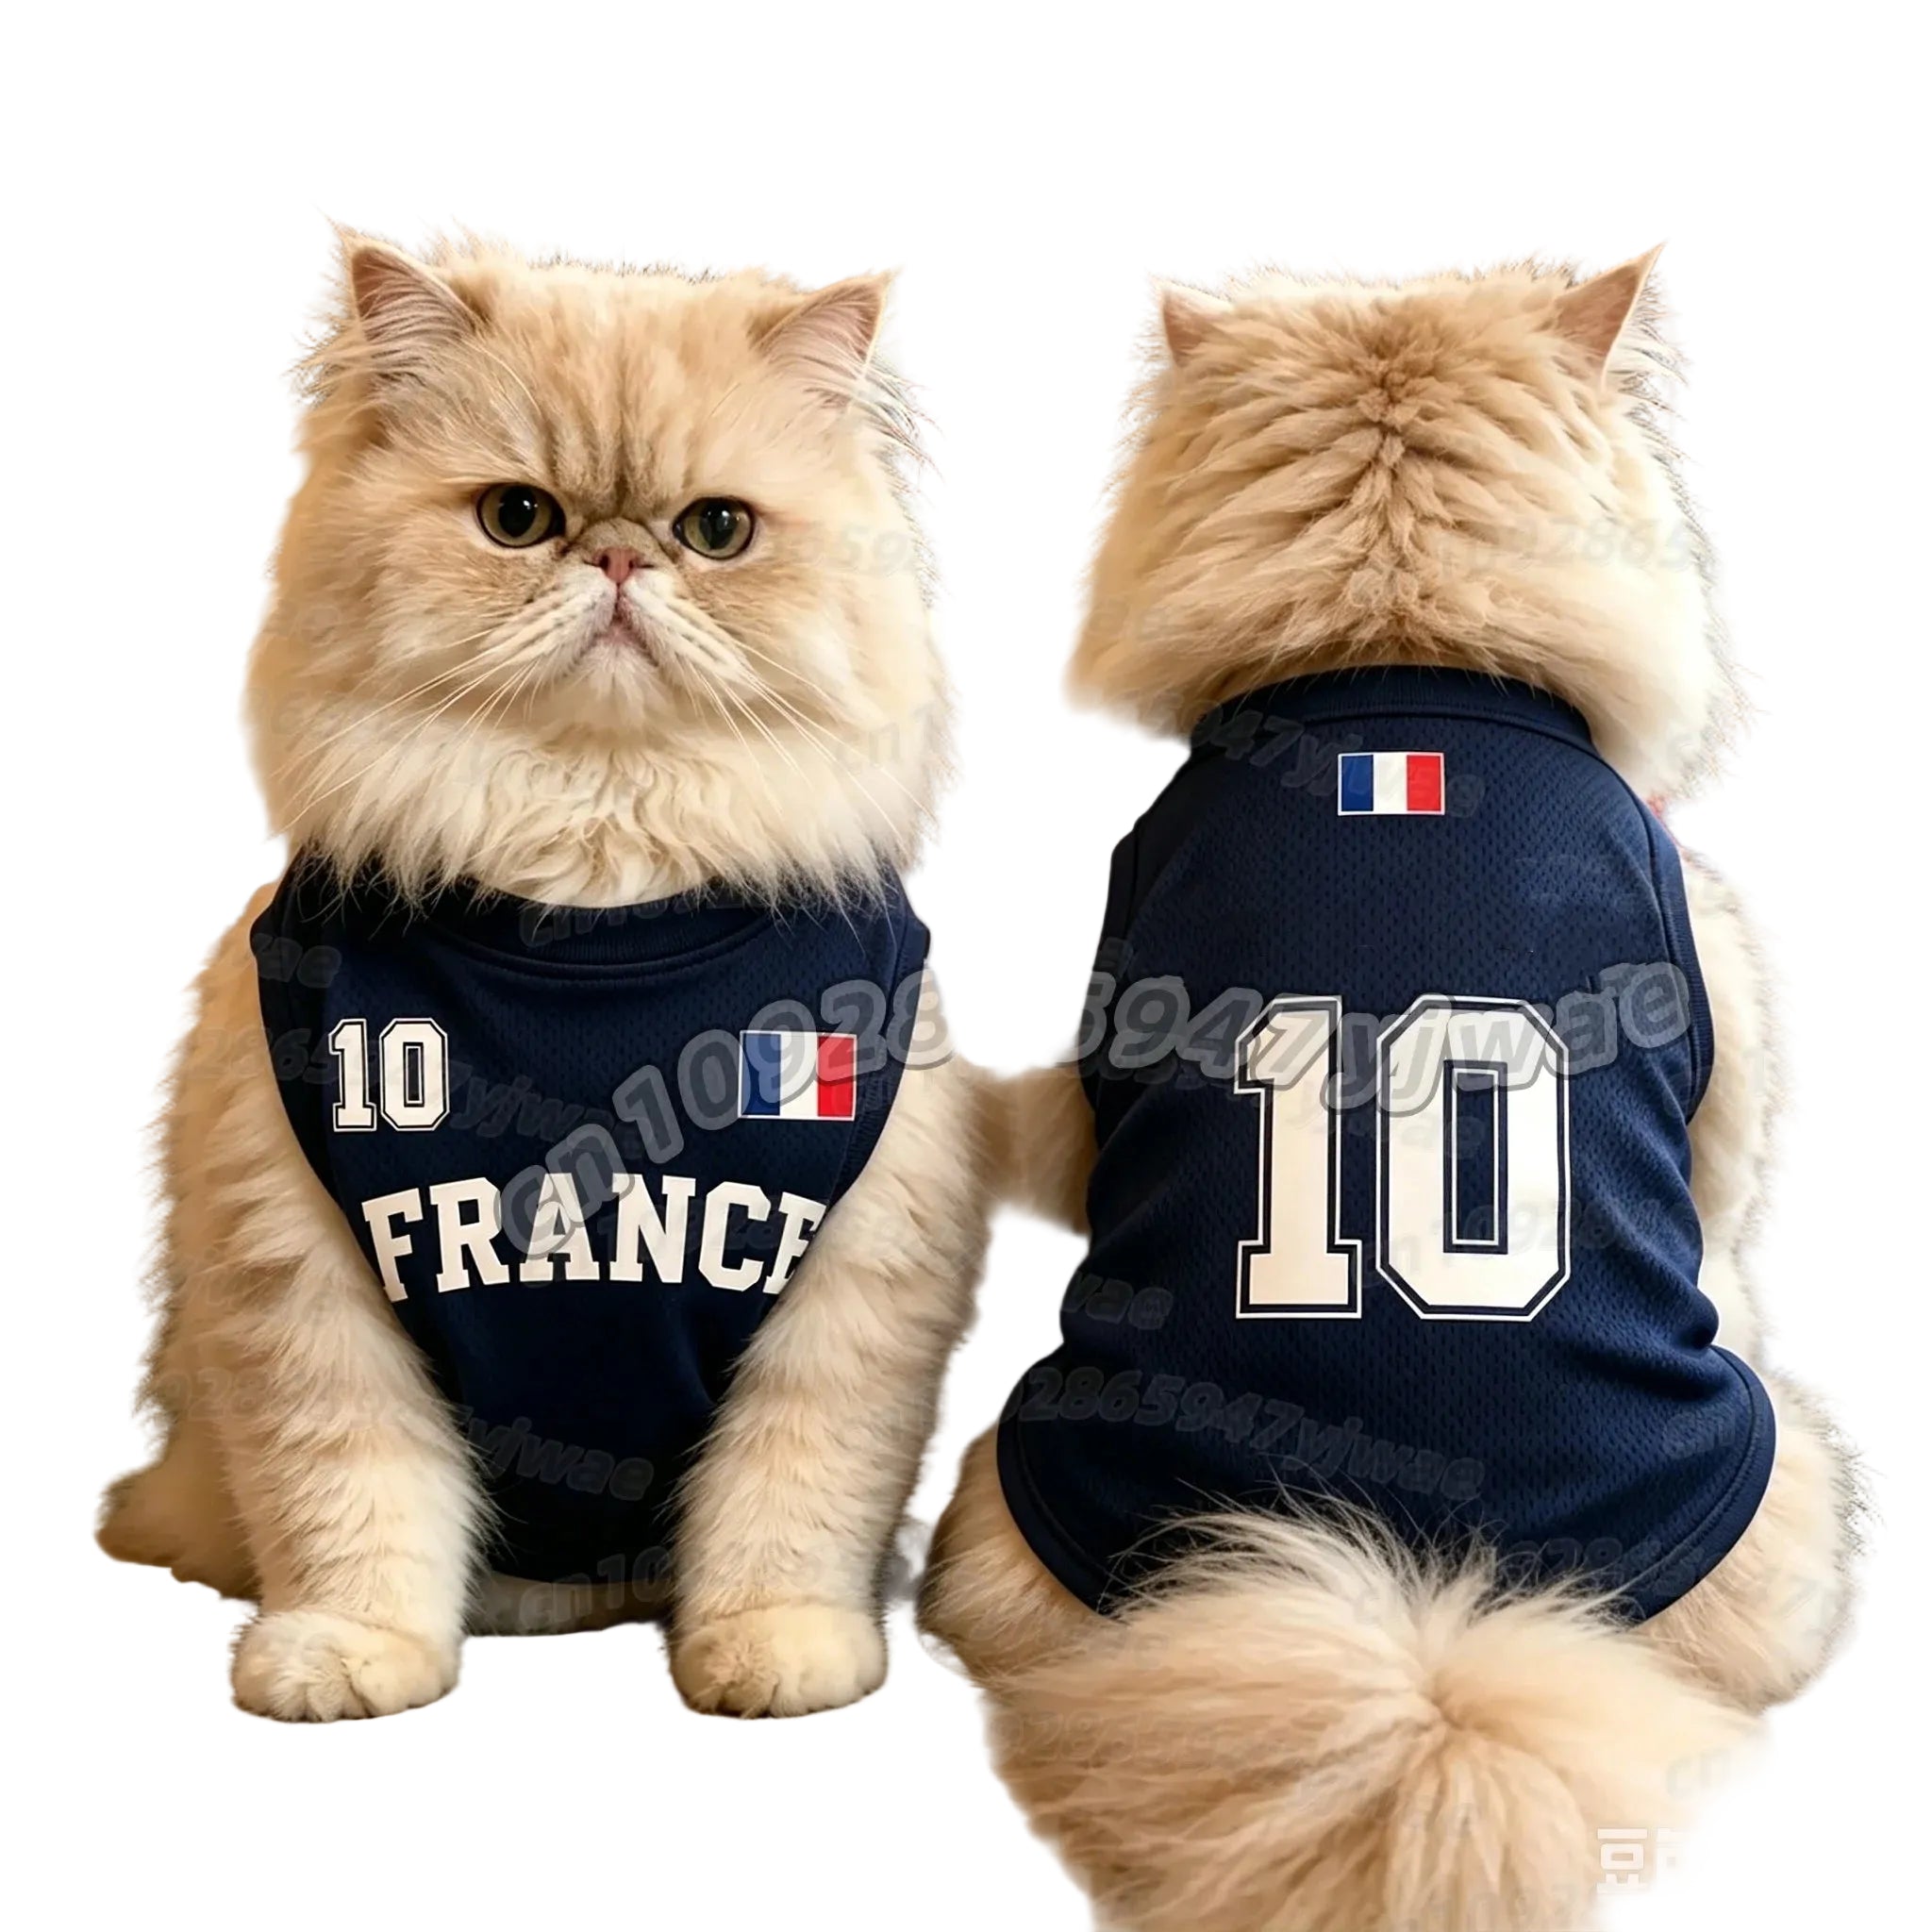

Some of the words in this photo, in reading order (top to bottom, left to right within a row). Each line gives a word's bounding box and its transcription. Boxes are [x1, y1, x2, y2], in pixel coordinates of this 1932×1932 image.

[327, 1017, 451, 1132] 10
[1234, 995, 1572, 1322] 10
[361, 1172, 828, 1303] FRANCE
